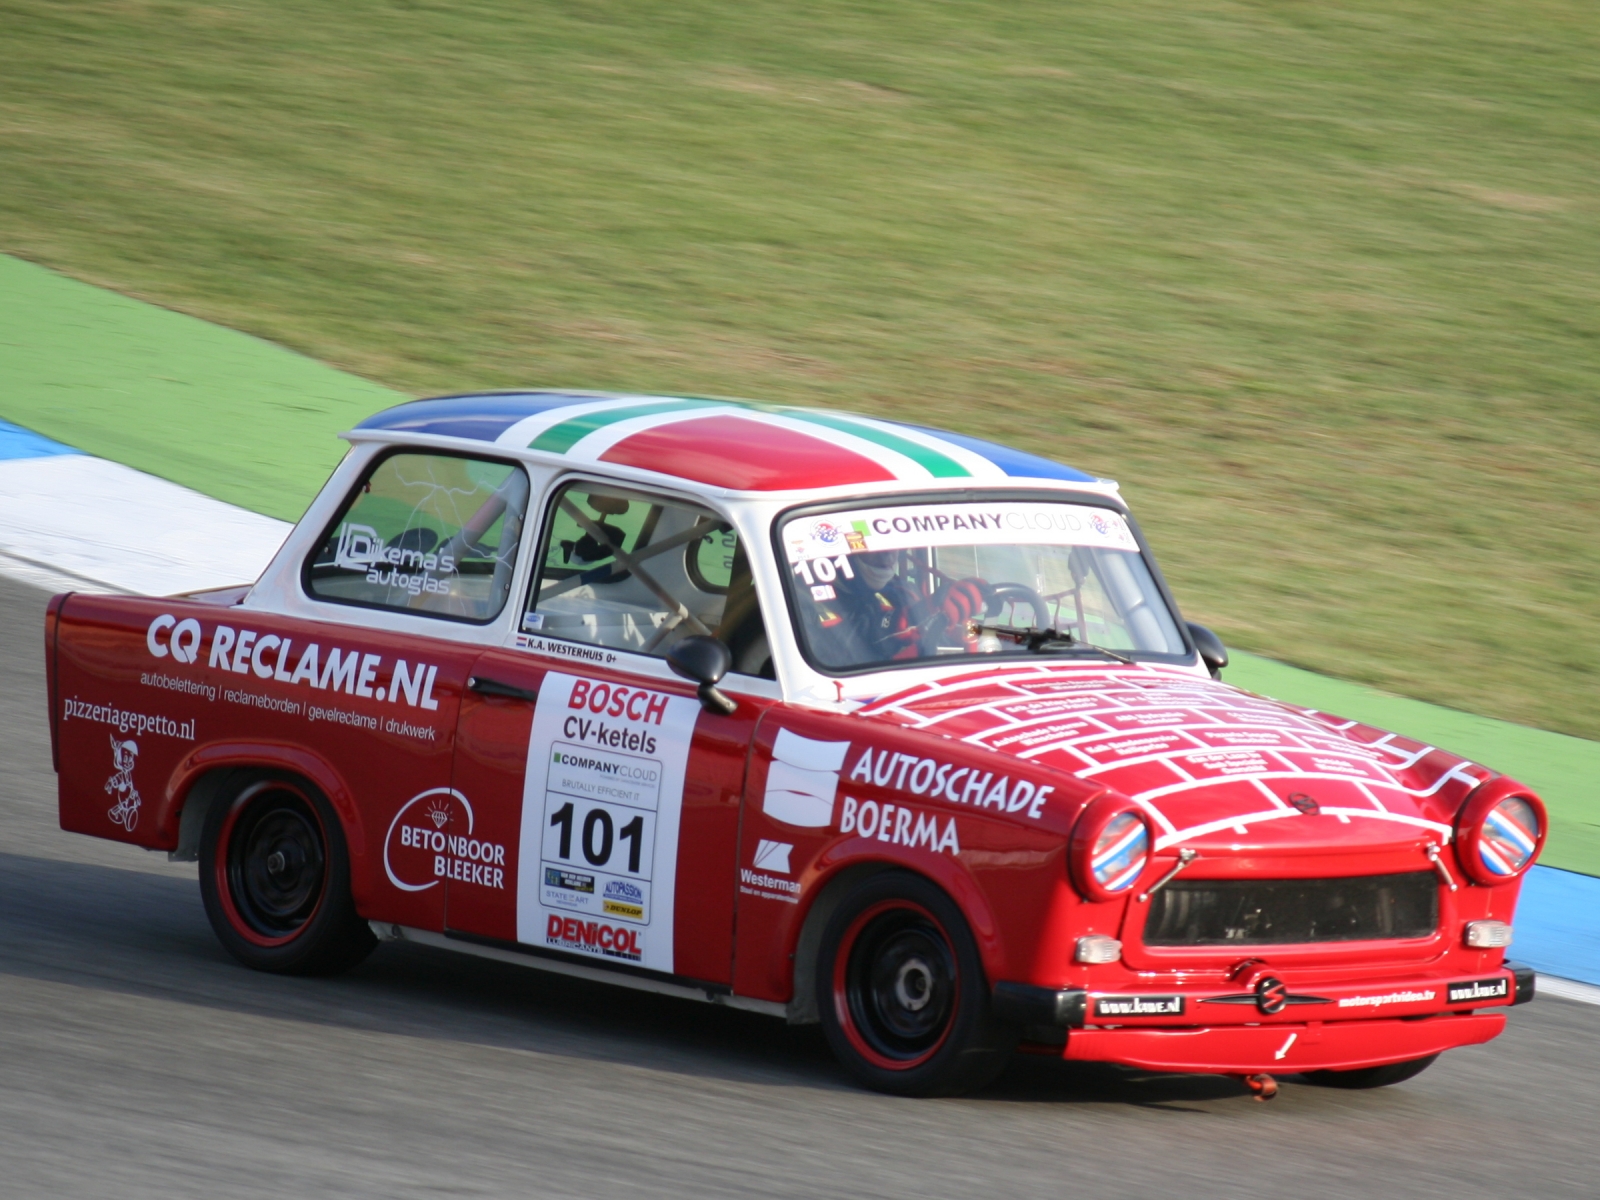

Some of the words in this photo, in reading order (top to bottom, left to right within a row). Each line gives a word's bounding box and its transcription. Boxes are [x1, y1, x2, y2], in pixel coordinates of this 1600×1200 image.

[366, 568, 450, 595] autoglas
[793, 553, 855, 585] 101
[146, 613, 201, 664] CQ
[208, 624, 439, 711] RECLAME.NL
[527, 638, 545, 651] K.A.
[547, 641, 604, 661] WESTERHUIS
[63, 694, 195, 741] pizzeriagepetto.nl
[140, 671, 216, 701] autobelettering
[224, 689, 300, 715] reclameborden
[308, 705, 377, 730] gevelreclame
[385, 718, 436, 741] drukwerk
[567, 679, 670, 725] BOSCH
[563, 715, 657, 754] CV-ketels
[562, 779, 596, 793] BRUTALLY
[597, 785, 632, 800] EFFICIENT
[633, 792, 640, 801] IT
[850, 746, 1055, 819] AUTOSCHADE
[550, 801, 644, 873] 101
[839, 796, 960, 857] BOERMA
[401, 825, 505, 866] BETONBOOR
[434, 855, 504, 890] BLEEKER
[605, 881, 642, 899] AUTOPASSION
[740, 868, 801, 894] Westerman
[546, 890, 568, 900] STATE
[575, 896, 589, 904] ART
[610, 904, 642, 915] DUNLOP
